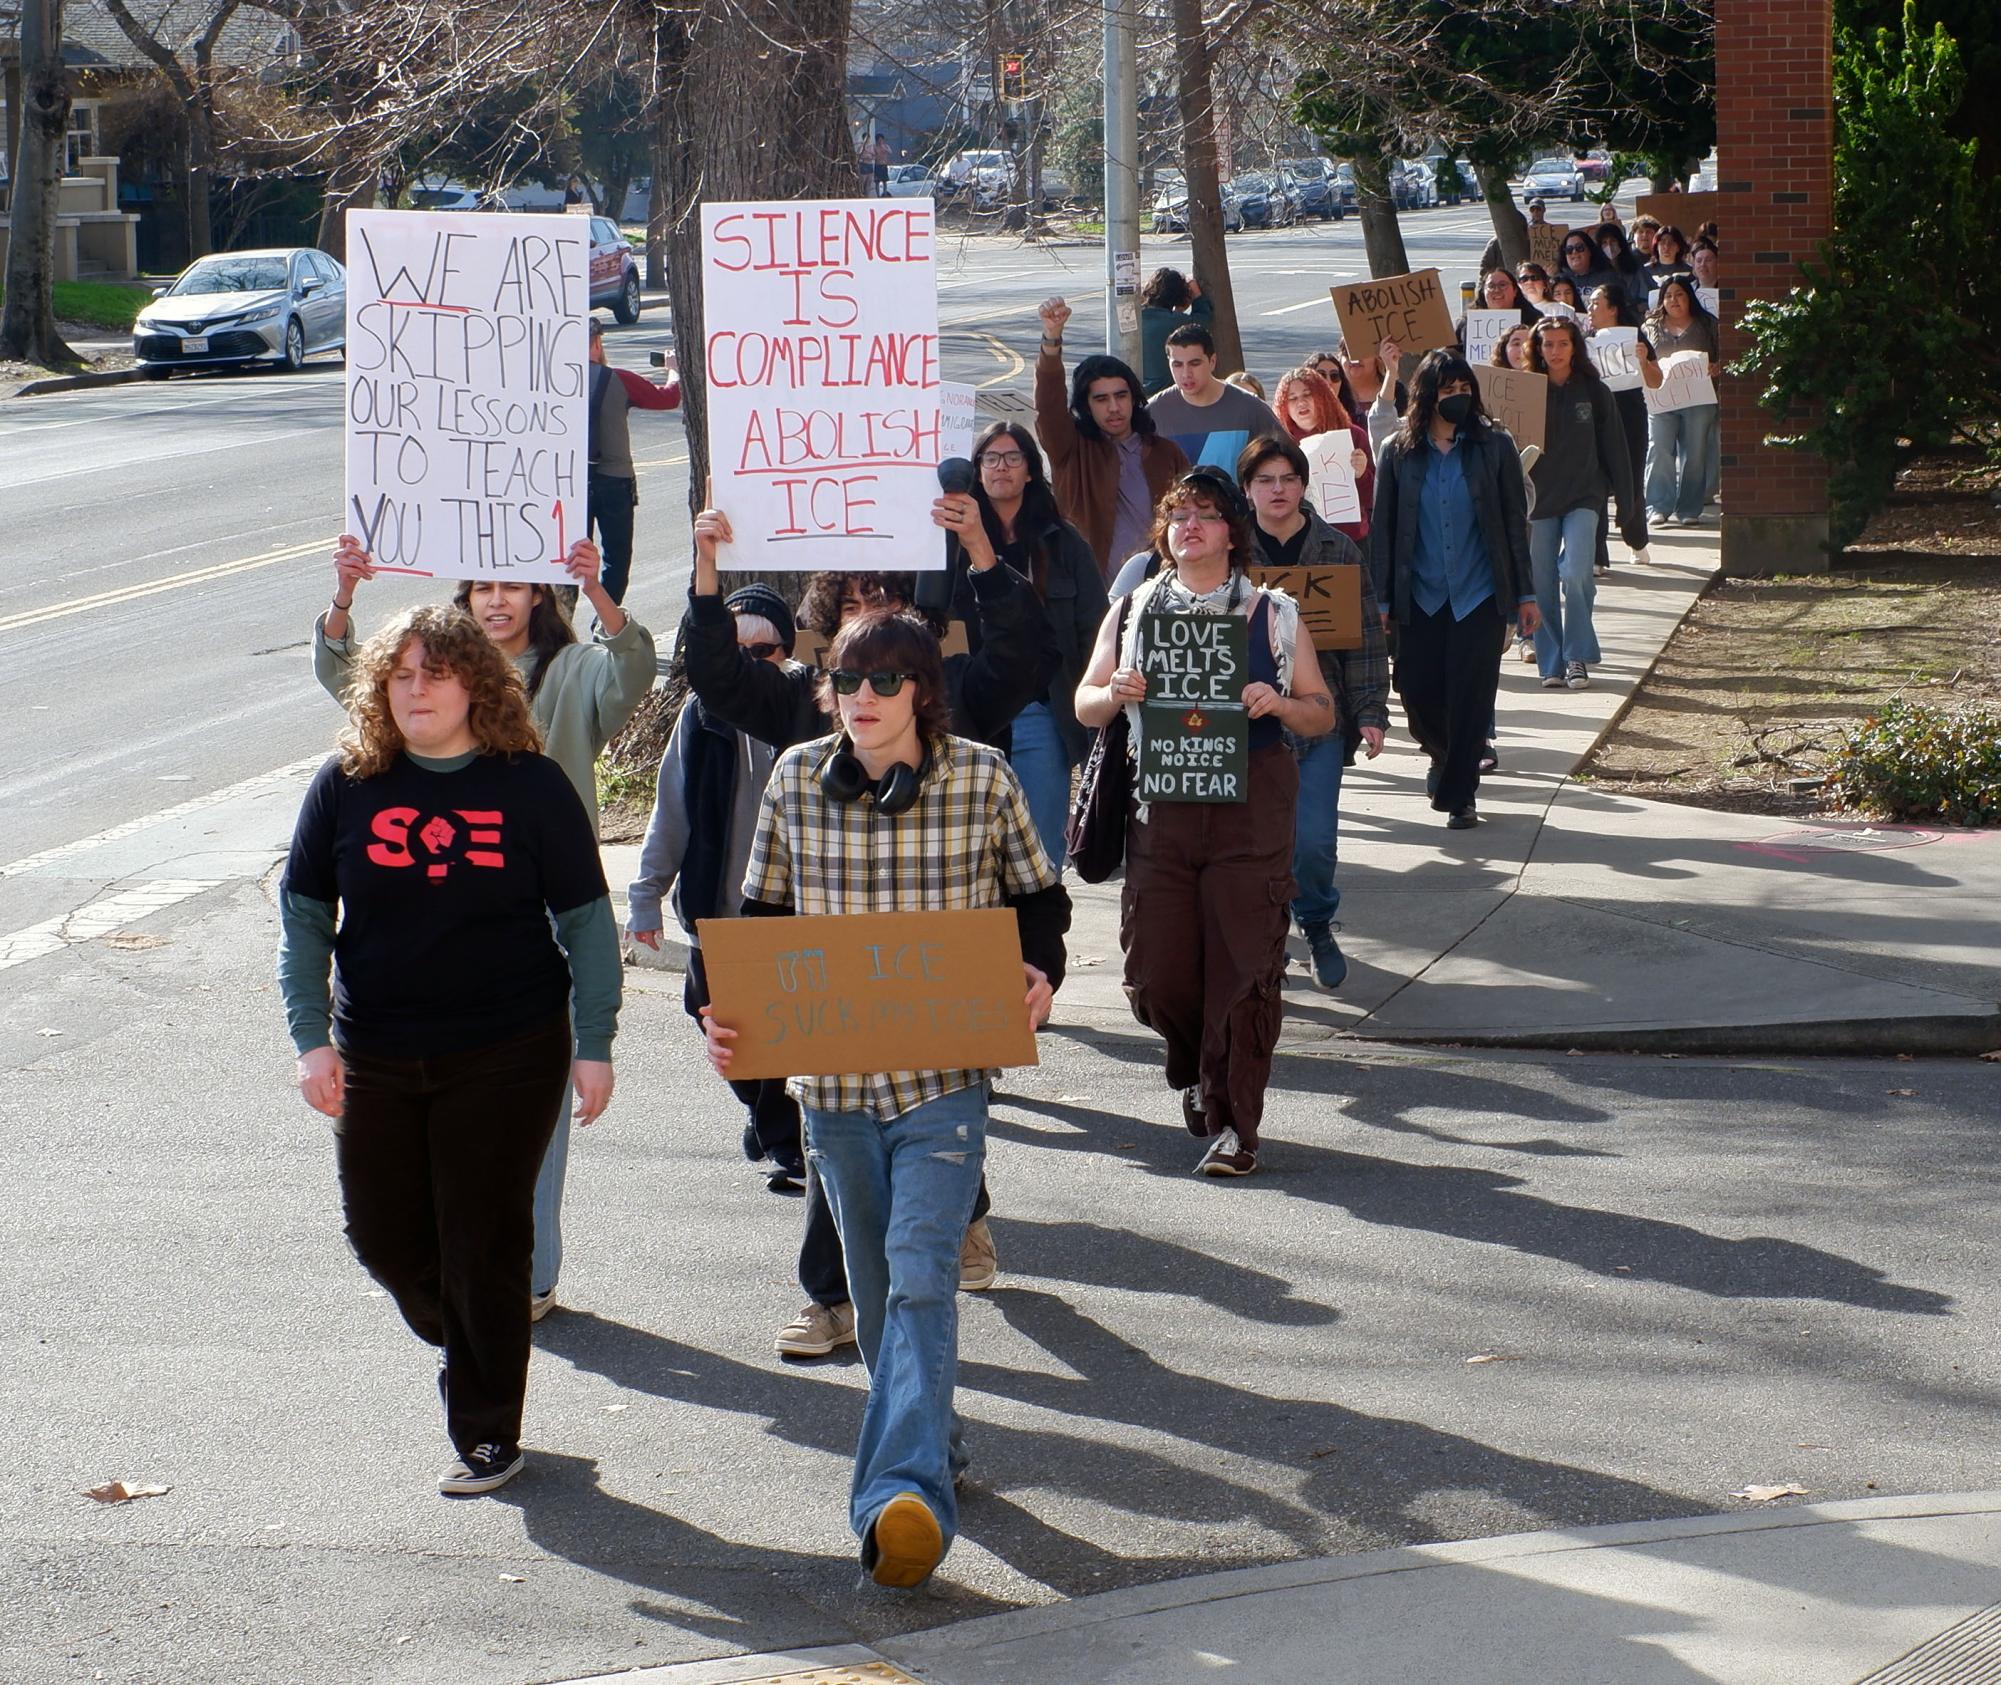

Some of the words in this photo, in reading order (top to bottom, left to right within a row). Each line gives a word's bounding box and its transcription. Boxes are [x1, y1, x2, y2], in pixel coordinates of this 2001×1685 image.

[713, 209, 930, 271] SILENCE
[360, 228, 483, 312] WE
[494, 236, 582, 317] ARE
[1348, 278, 1436, 315] ABOLISH
[779, 270, 858, 328] IS
[1368, 308, 1423, 344] ICE
[355, 303, 583, 398] SKIPPING
[708, 331, 940, 389] COMPLIANCE
[1596, 340, 1637, 379] ICE
[351, 375, 421, 431] OUR
[438, 384, 568, 437] LESSONS
[1488, 373, 1516, 401] ICE
[740, 408, 942, 469] ABOLISH
[355, 431, 428, 486] TO
[448, 438, 574, 498] TEACH
[771, 475, 878, 535] ICE
[352, 493, 421, 566] YOU
[440, 498, 545, 569] THIS
[550, 499, 567, 563] 1
[1154, 619, 1232, 650] LOVE
[1146, 648, 1236, 675] MELTS
[1150, 738, 1175, 753] NO
[1180, 735, 1236, 754] KINGS
[1161, 753, 1184, 767] NO
[1144, 773, 1176, 794] NO
[1182, 772, 1237, 797] FEAR
[863, 943, 945, 981] ICE
[765, 997, 861, 1045] SUCK
